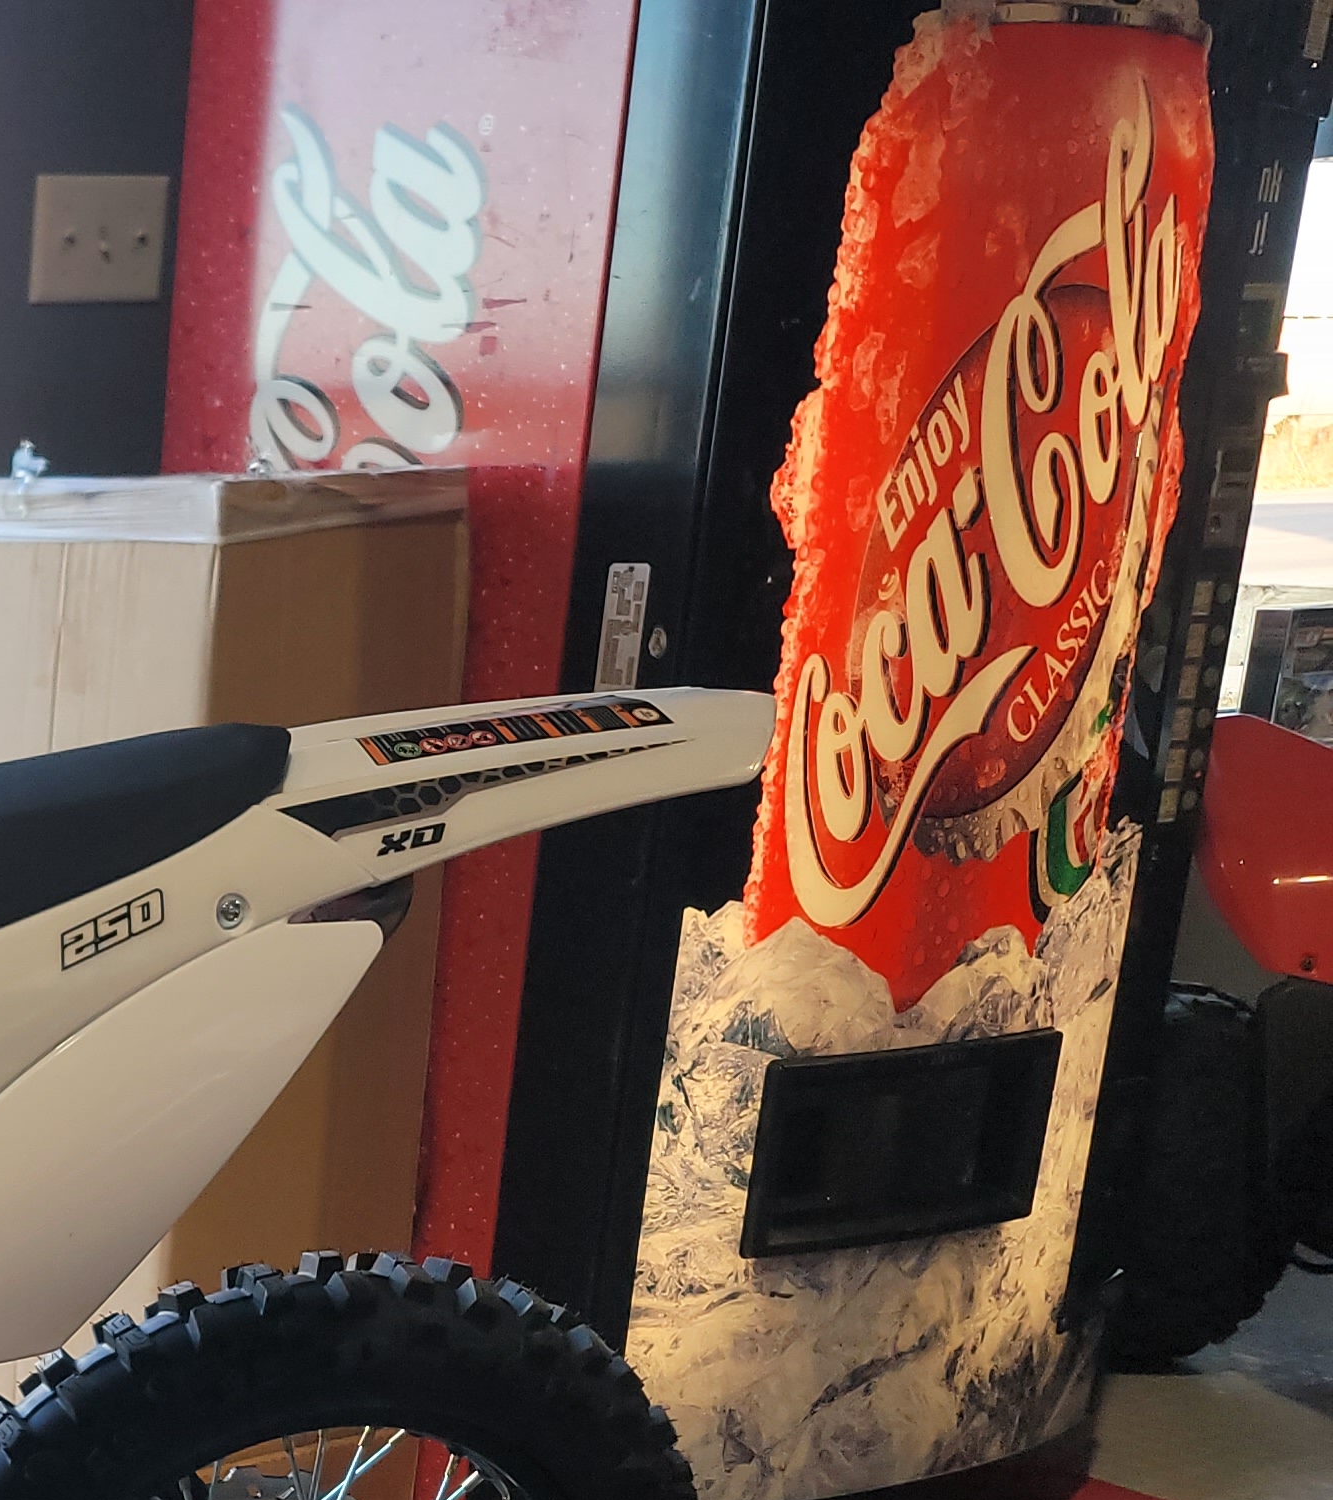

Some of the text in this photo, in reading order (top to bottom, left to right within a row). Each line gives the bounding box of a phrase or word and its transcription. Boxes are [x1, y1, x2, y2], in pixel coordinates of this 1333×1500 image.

[785, 75, 1185, 928] Coca-Cola
[876, 372, 971, 552] Enjoy
[1006, 559, 1112, 743] CLASSIC
[60, 887, 165, 972] 250
[376, 822, 447, 857] XD
